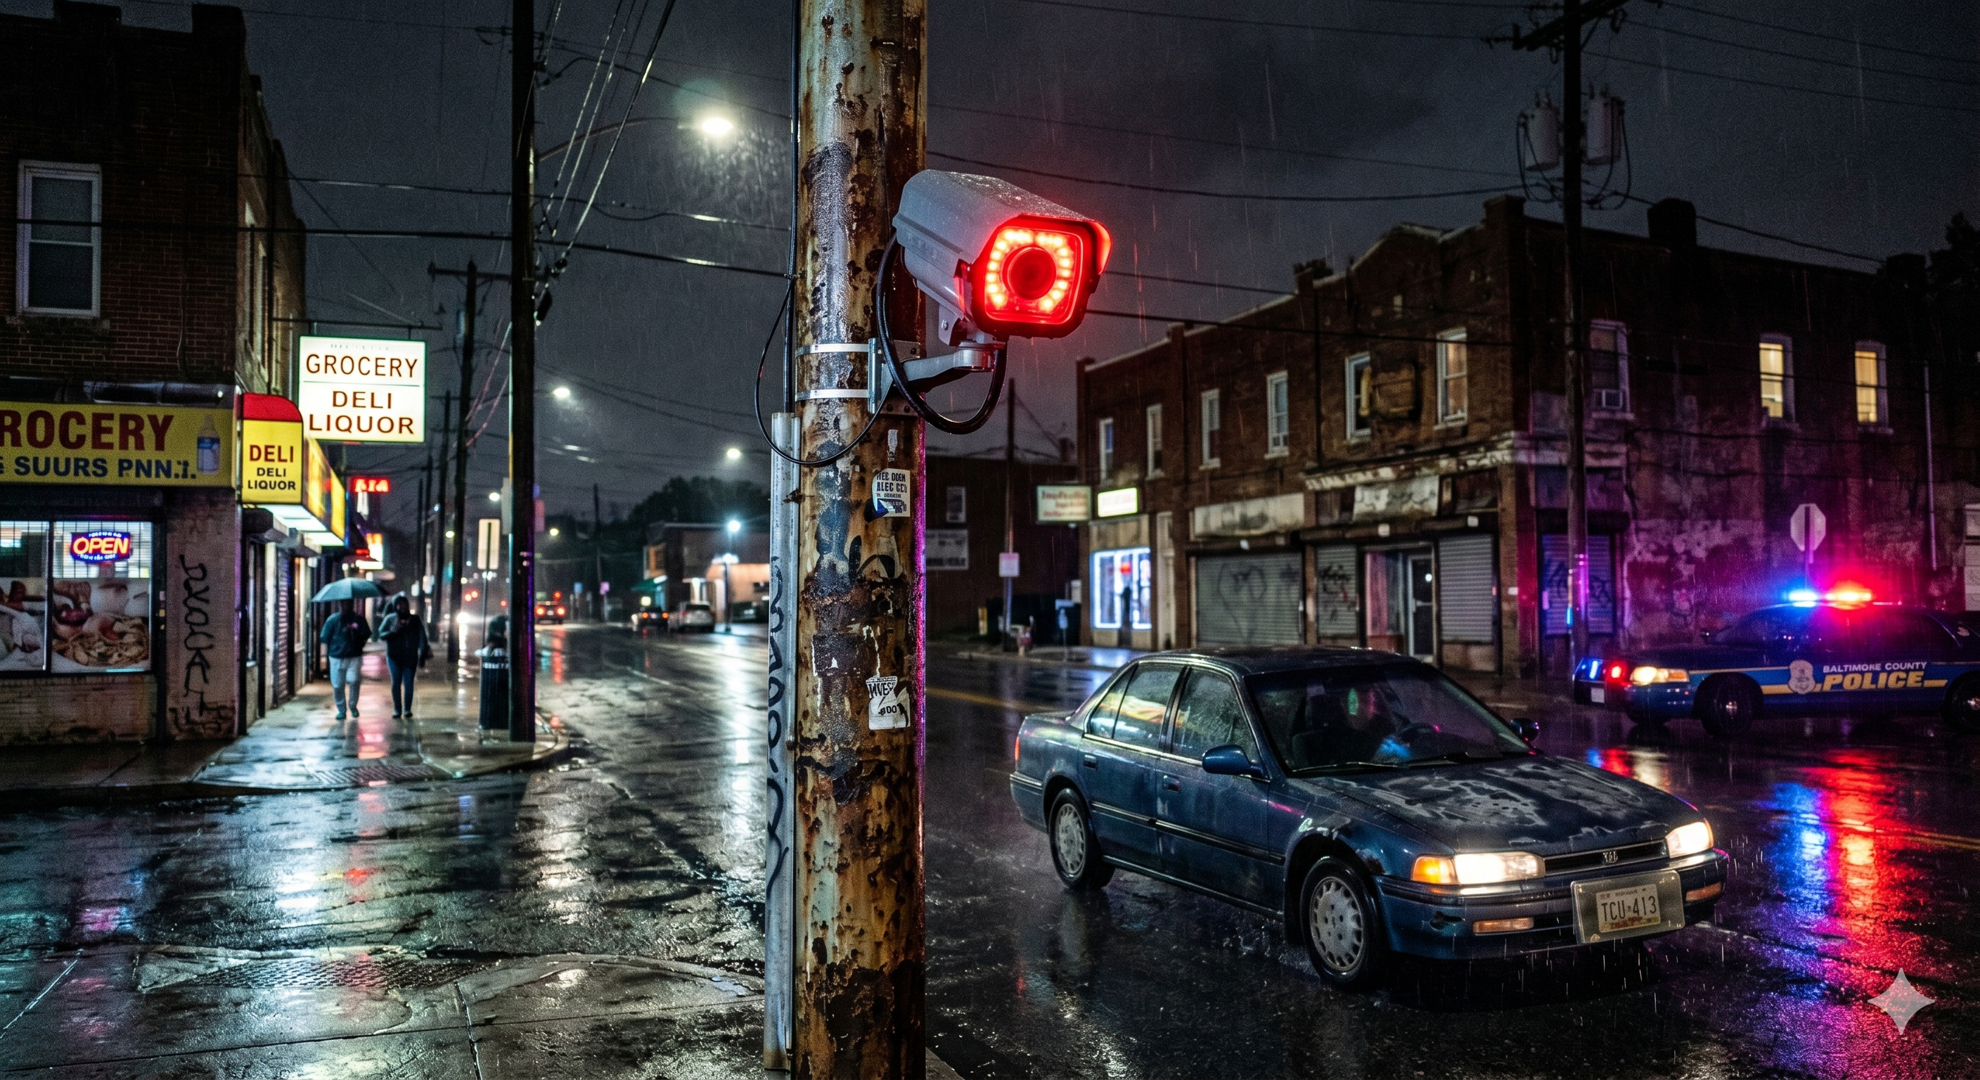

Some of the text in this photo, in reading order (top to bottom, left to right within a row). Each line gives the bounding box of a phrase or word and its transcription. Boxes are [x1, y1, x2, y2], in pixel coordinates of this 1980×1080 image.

[306, 353, 418, 378] GROCERY
[332, 390, 392, 409] DELI
[309, 414, 414, 435] LIQUOR
[249, 444, 294, 463] DELI
[14, 456, 109, 478] SUURS
[257, 467, 286, 478] DELI
[247, 480, 297, 490] LIQUOR
[73, 537, 129, 554] OPEN
[1823, 662, 1928, 673] BALTIMORE COUNTY
[1822, 671, 1925, 691] POLICE
